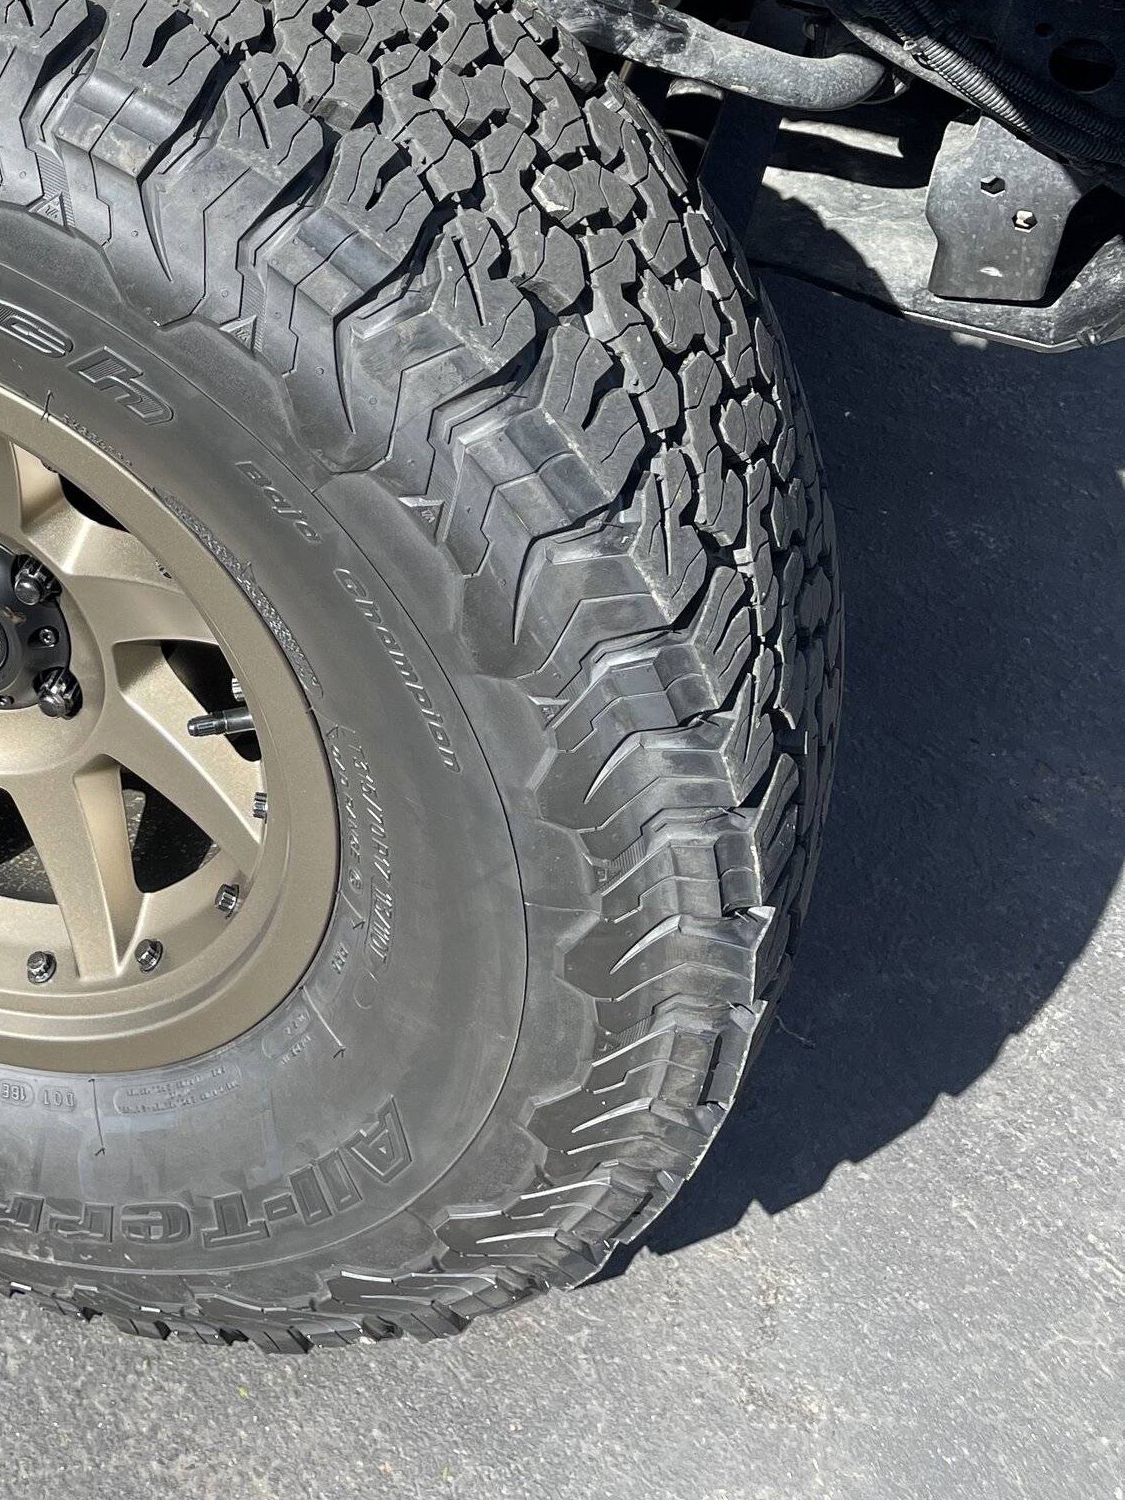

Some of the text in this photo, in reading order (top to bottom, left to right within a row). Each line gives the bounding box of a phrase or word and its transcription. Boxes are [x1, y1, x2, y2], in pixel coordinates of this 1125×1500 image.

[234, 461, 323, 545] Baja
[332, 567, 461, 773] Champion
[42, 1086, 76, 1111] DOT
